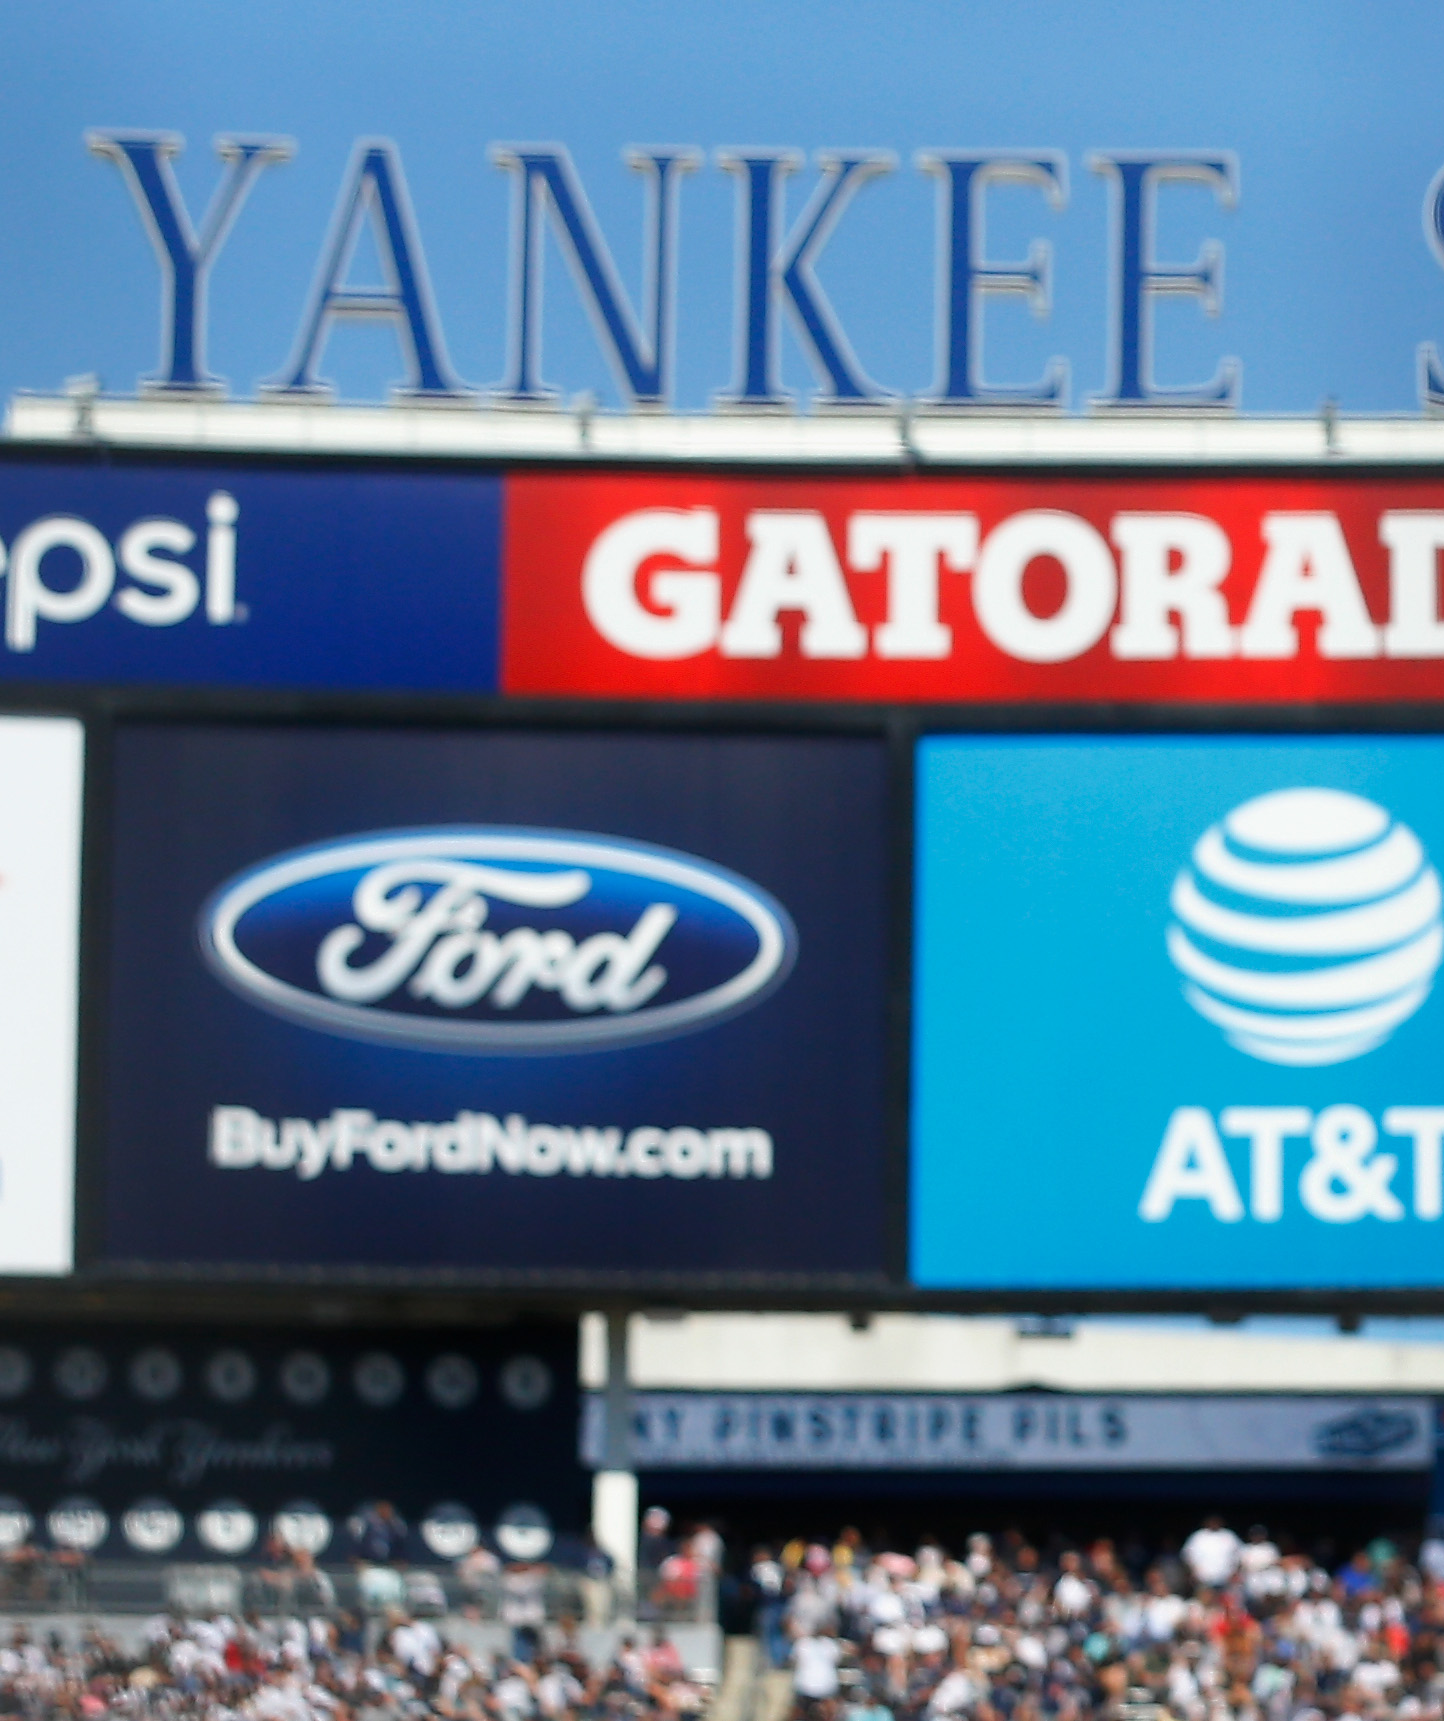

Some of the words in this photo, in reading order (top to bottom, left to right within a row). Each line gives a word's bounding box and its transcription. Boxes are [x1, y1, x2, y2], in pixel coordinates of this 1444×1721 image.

[86, 128, 1242, 412] YANKEE
[0, 489, 238, 653] psi
[316, 858, 678, 1012] Ford
[209, 1105, 774, 1180] BuyFordNow.com
